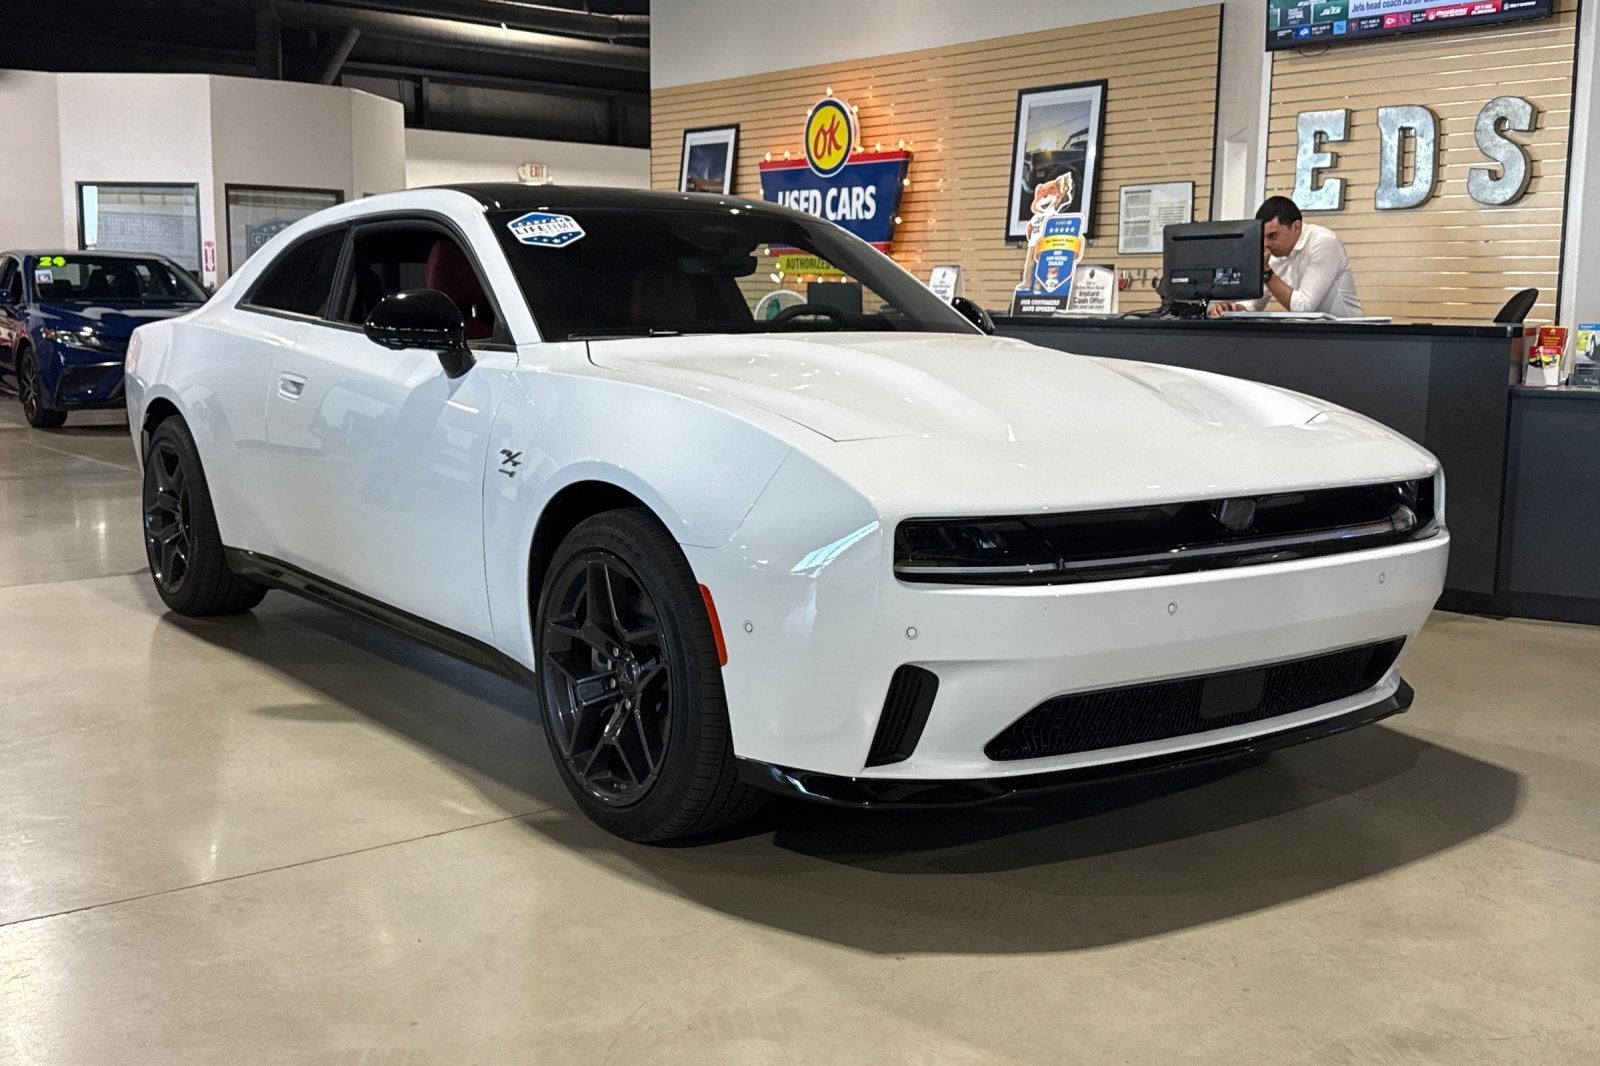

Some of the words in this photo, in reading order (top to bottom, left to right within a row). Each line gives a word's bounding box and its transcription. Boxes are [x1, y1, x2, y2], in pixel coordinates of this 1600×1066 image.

[1352, 3, 1365, 12] Jets
[1366, 2, 1381, 10] head
[1382, 0, 1401, 8] coach
[813, 114, 842, 160] OK
[530, 165, 544, 177] EXIT
[777, 189, 822, 217] USED
[825, 185, 877, 221] CARS
[39, 256, 66, 267] 24
[785, 257, 831, 270] AUTHORIZED
